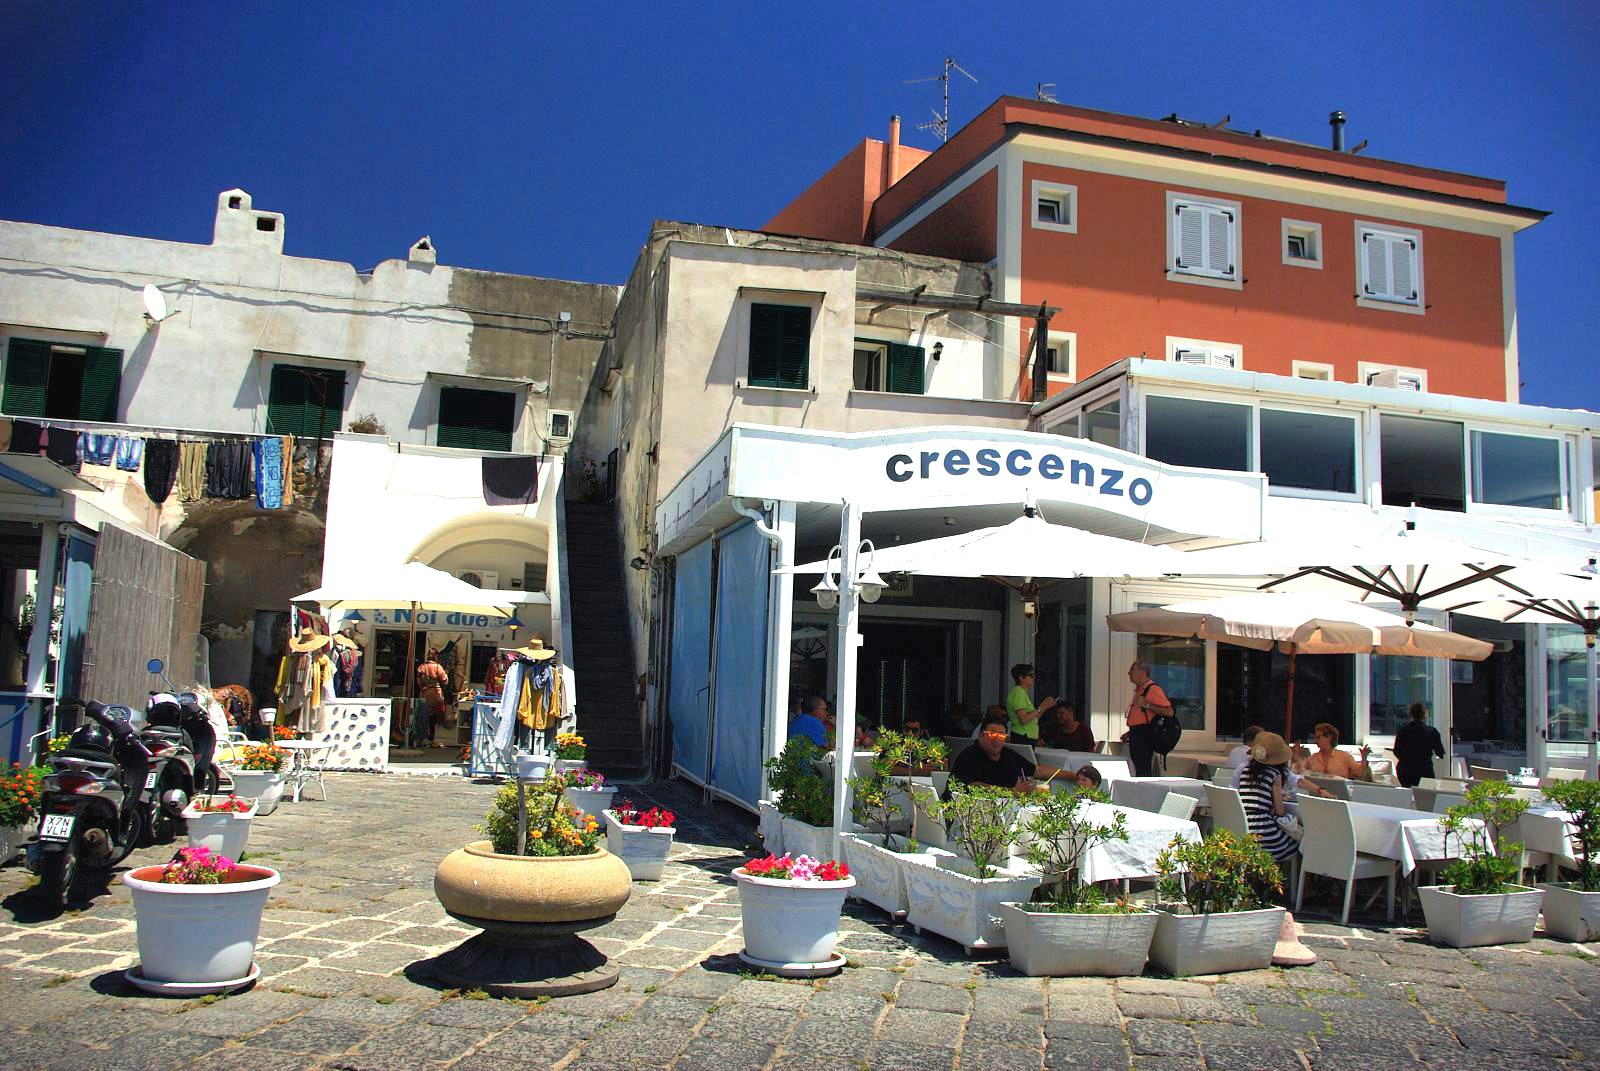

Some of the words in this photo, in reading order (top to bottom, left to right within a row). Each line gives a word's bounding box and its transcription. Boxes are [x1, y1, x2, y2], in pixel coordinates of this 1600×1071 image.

[886, 448, 1153, 506] crescenzo
[394, 609, 436, 625] Noi
[446, 611, 489, 627] due
[48, 816, 70, 827] X7N
[46, 826, 67, 836] VLH
